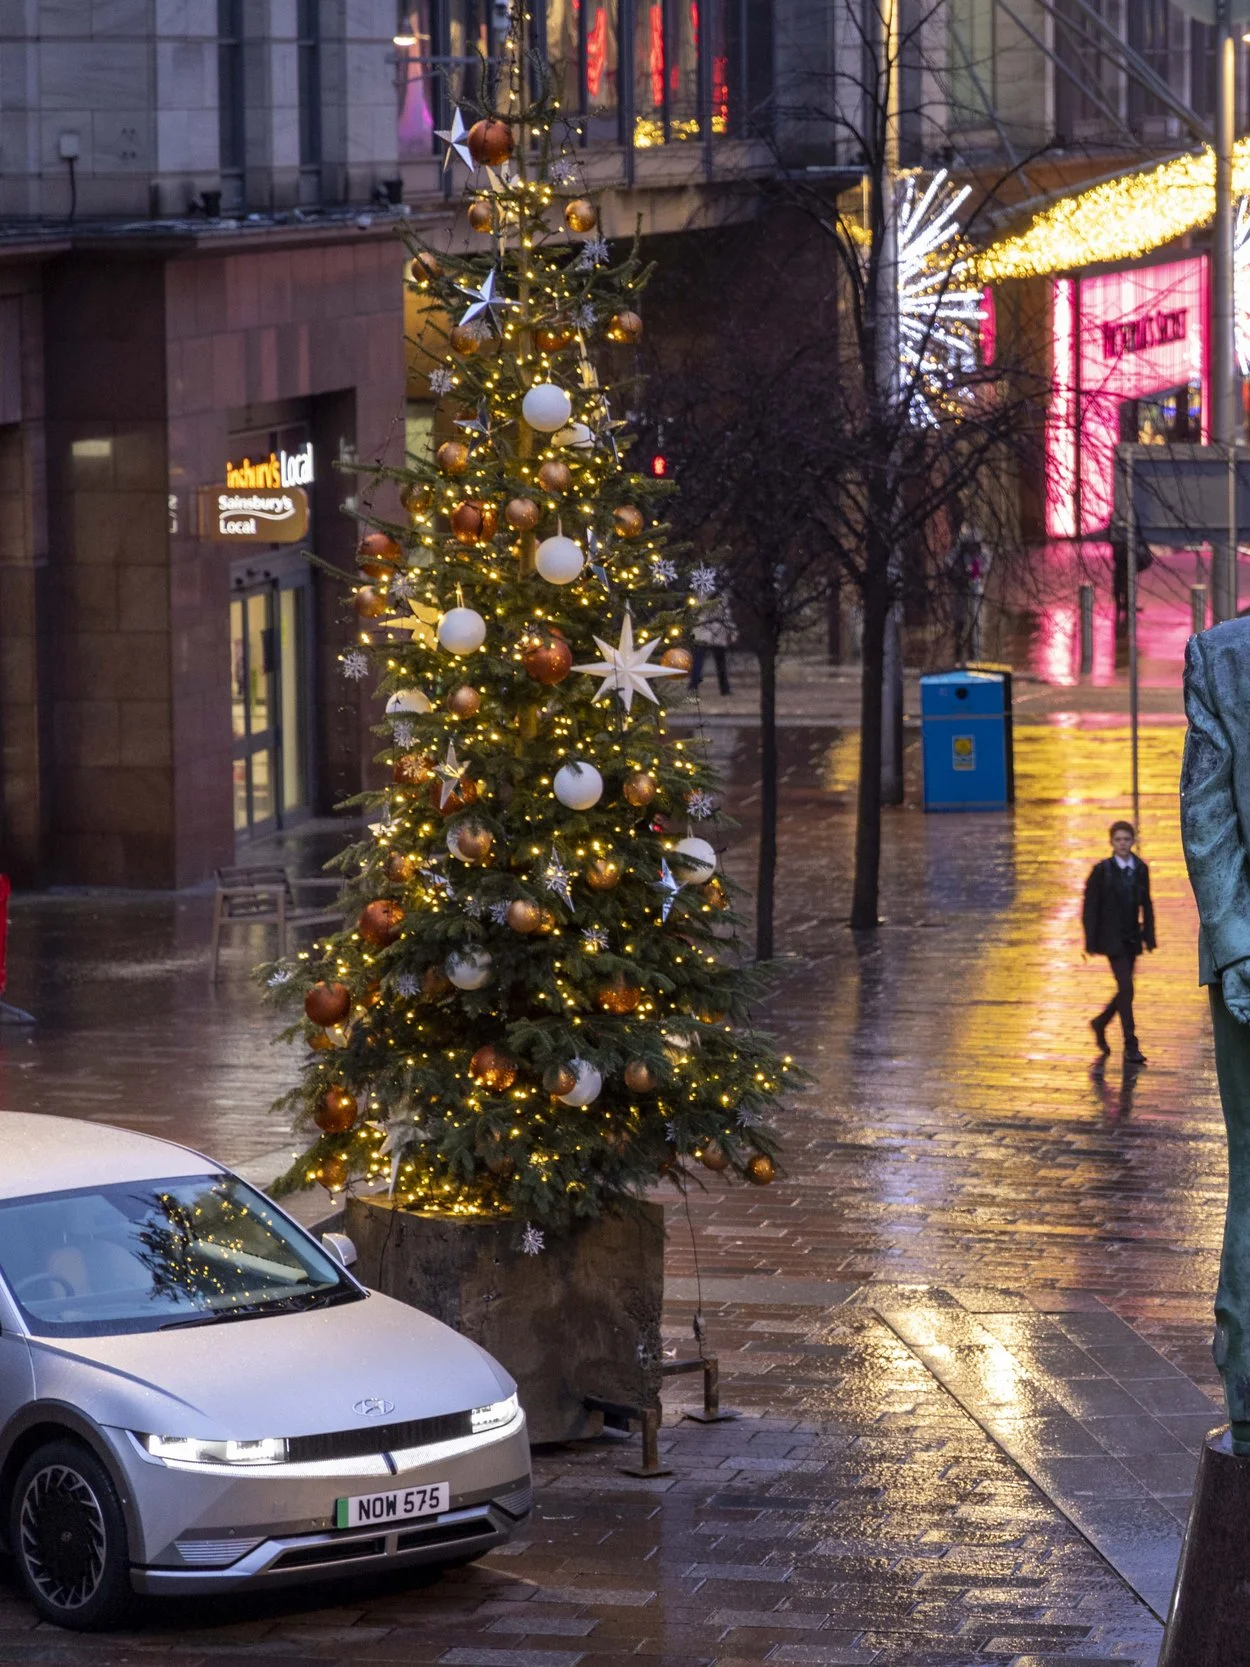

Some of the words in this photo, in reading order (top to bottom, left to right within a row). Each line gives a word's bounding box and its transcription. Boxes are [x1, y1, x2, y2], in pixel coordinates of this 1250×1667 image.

[226, 452, 281, 489] insbury's
[280, 441, 315, 488] Local
[218, 494, 294, 513] Sainsbury's
[219, 518, 257, 535] Local
[358, 1494, 397, 1521] NOW
[403, 1487, 440, 1514] 575
